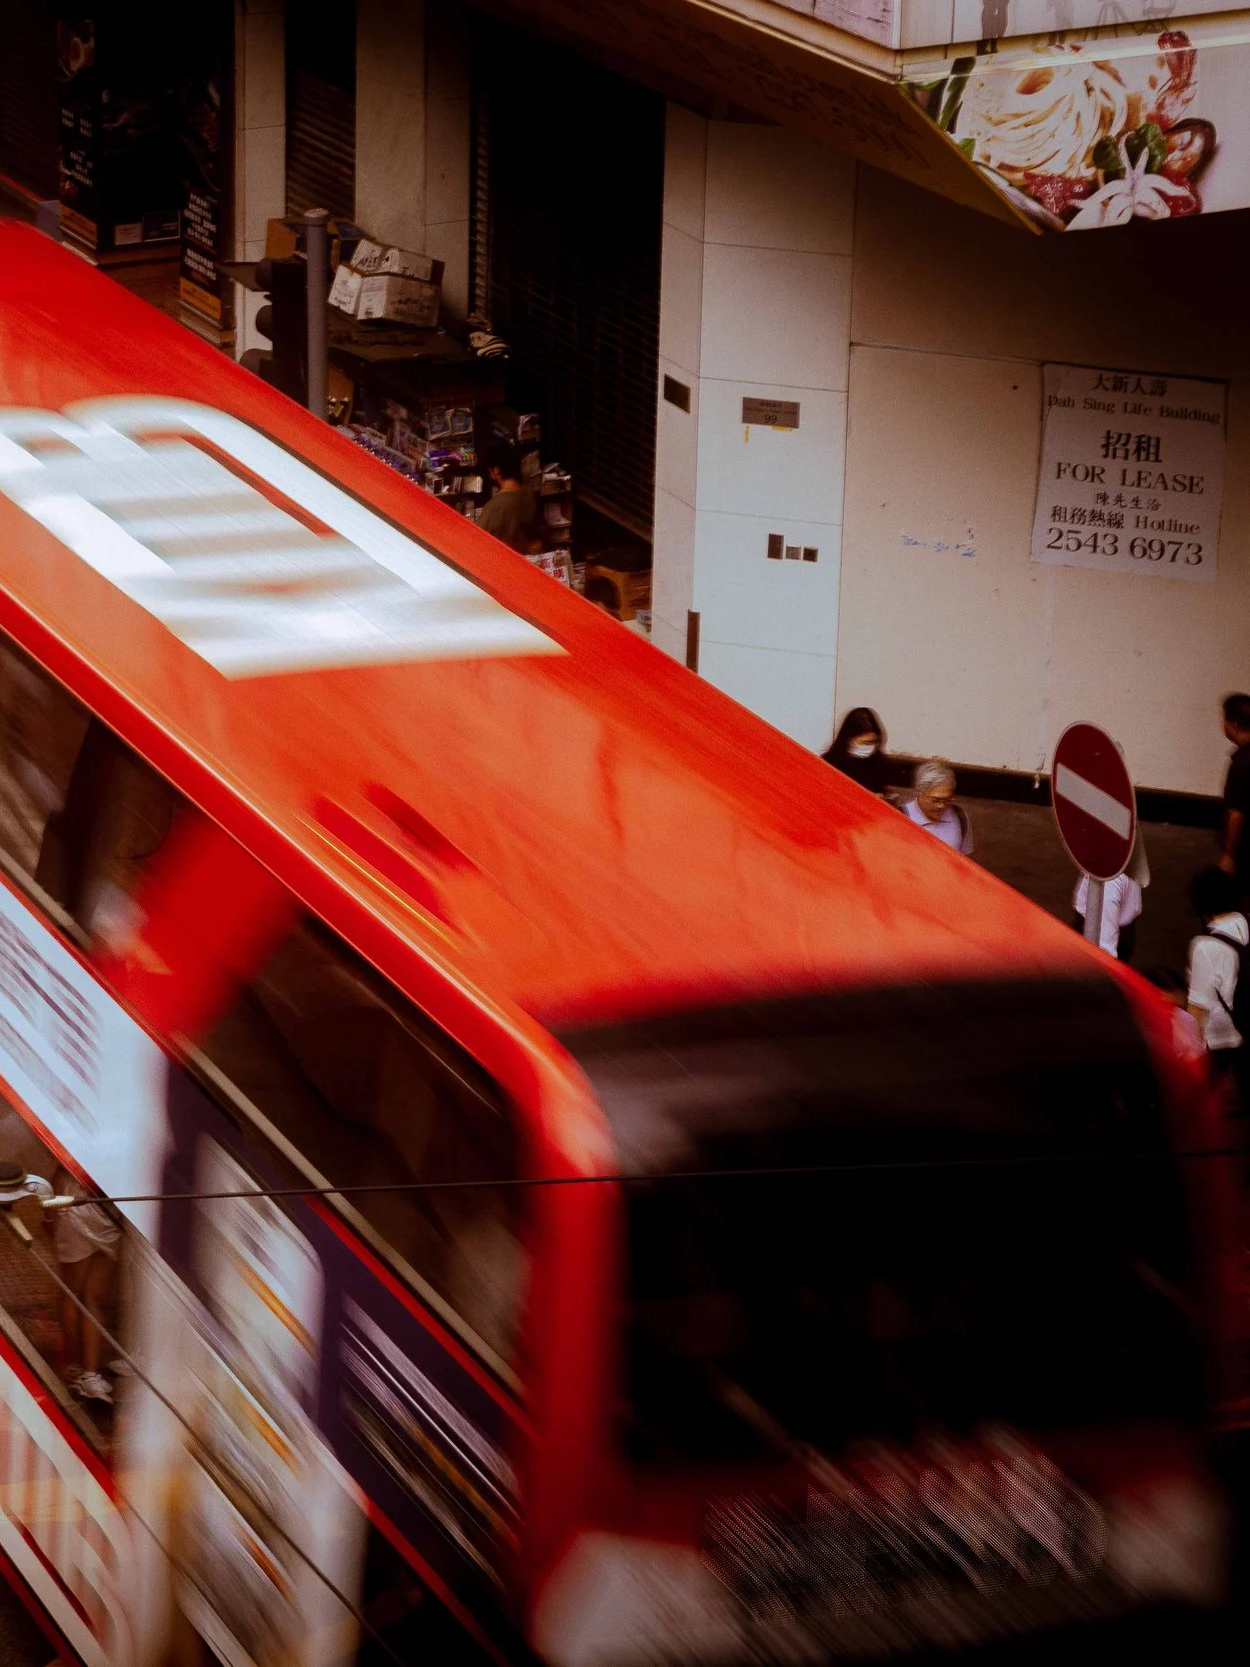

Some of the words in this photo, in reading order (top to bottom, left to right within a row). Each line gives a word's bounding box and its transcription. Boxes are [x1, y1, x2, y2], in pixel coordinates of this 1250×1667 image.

[1047, 395, 1076, 409] Dah
[1082, 397, 1116, 415] Sing
[1123, 401, 1153, 416] Life
[1159, 405, 1221, 425] Building
[1101, 429, 1163, 463] 招租
[1055, 461, 1107, 484] FOR
[1120, 468, 1205, 495] LEASE
[1050, 504, 1125, 529] 租務熱線
[1134, 514, 1201, 535] Hotline
[1046, 526, 1120, 557] 2543
[1129, 536, 1204, 566] 6973
